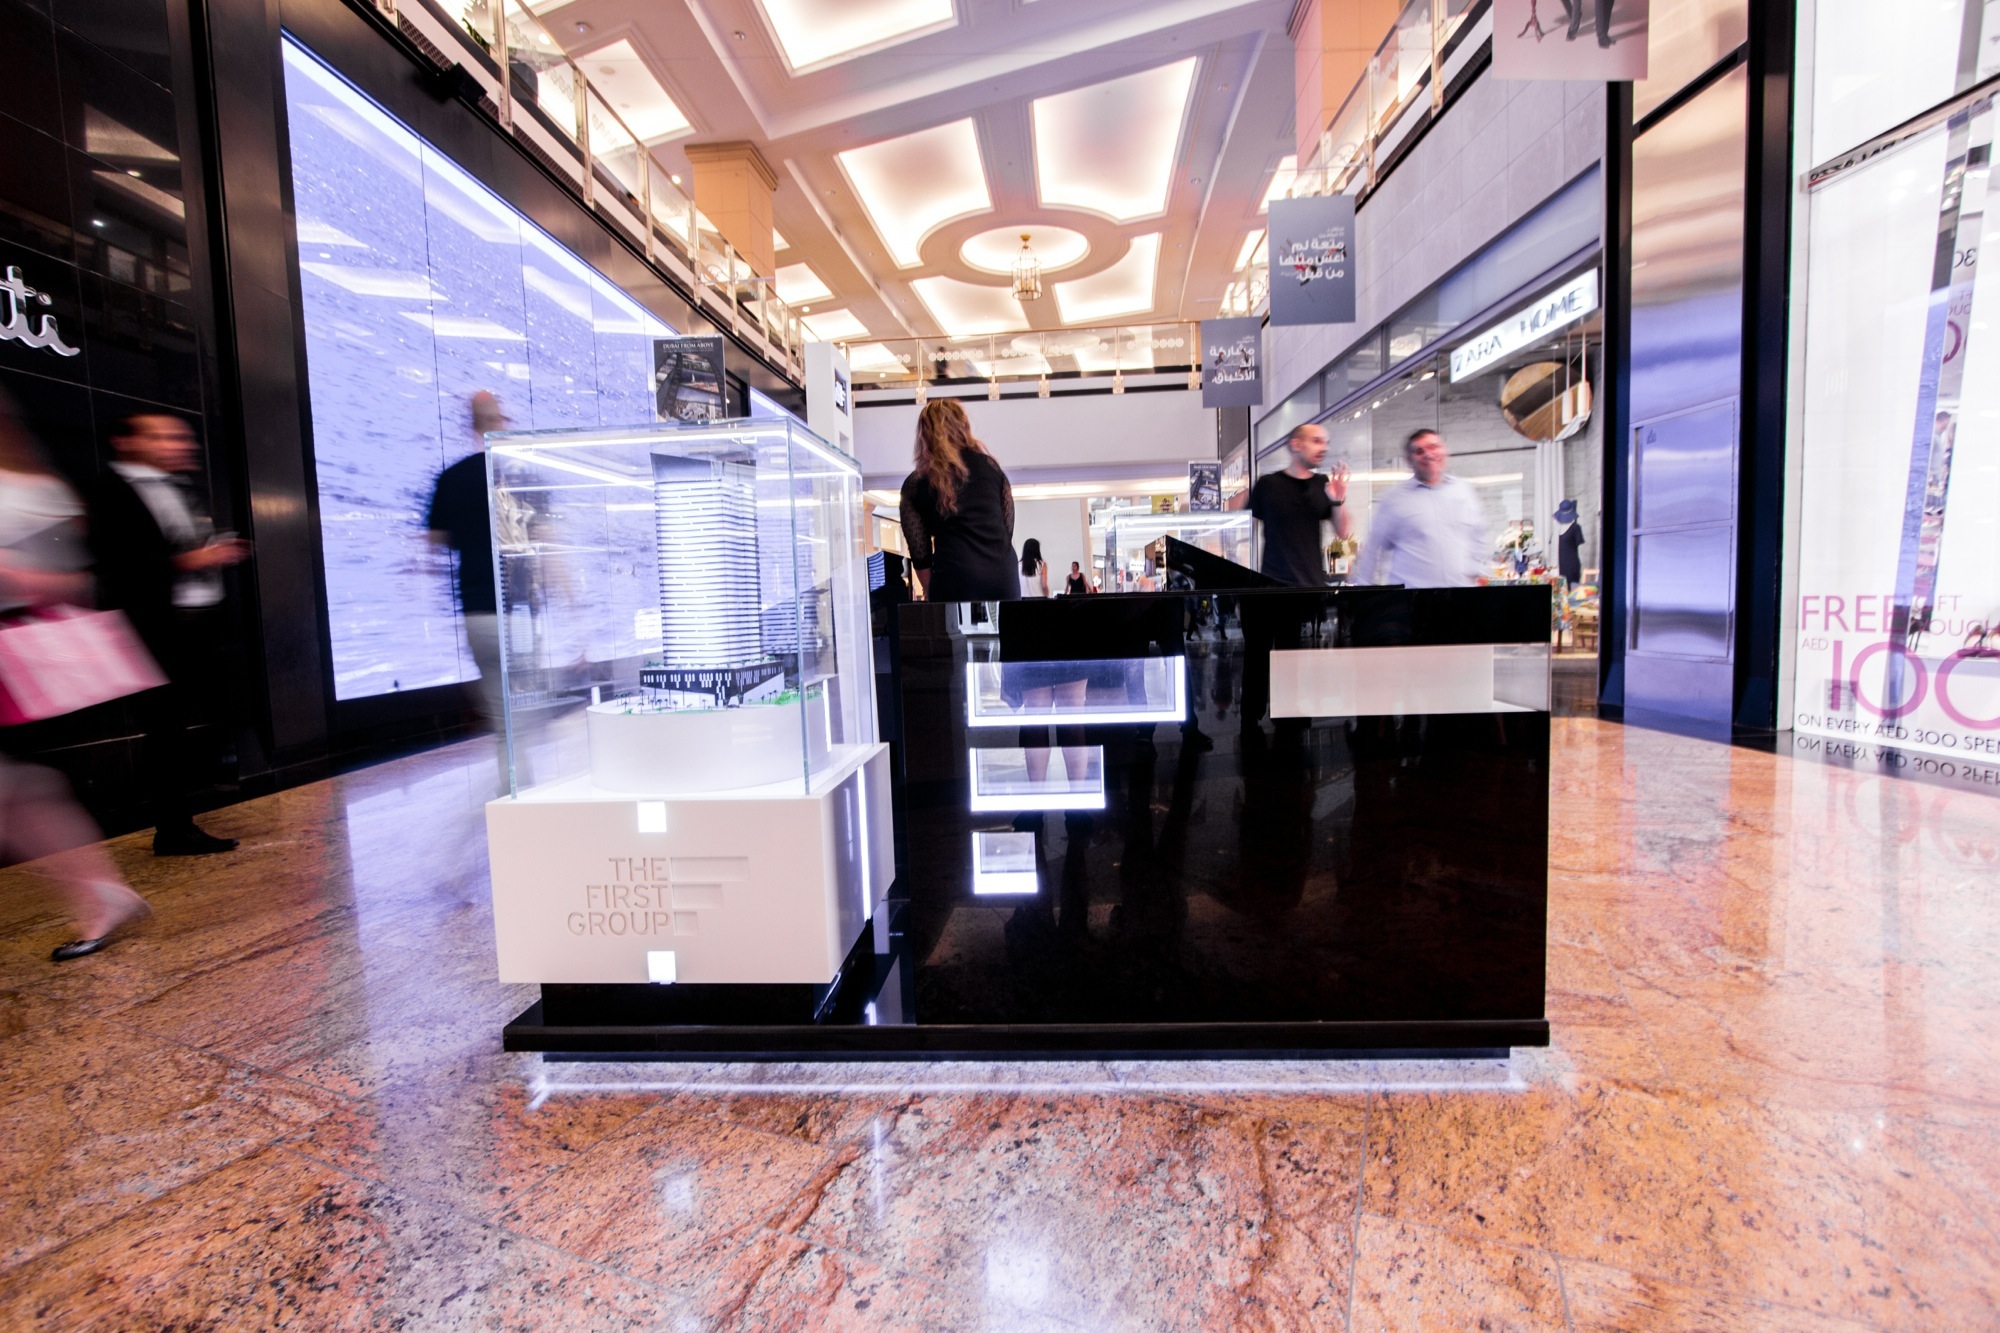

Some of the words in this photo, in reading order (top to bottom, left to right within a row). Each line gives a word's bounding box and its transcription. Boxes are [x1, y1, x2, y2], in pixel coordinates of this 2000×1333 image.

[1291, 239, 1309, 254] لم
[1311, 238, 1345, 250] متعة
[1325, 267, 1345, 280] من
[1455, 335, 1502, 372] ZARA
[1520, 288, 1583, 336] HOME
[1801, 595, 1902, 633] FREE
[1802, 638, 1829, 651] AED
[1797, 713, 1822, 728] ON
[1826, 717, 1871, 734] EVERY
[1874, 724, 1909, 741] AED
[1914, 729, 1957, 748] 300
[608, 857, 669, 882] THE
[586, 884, 669, 909] FIRST
[567, 911, 670, 936] GROUP
